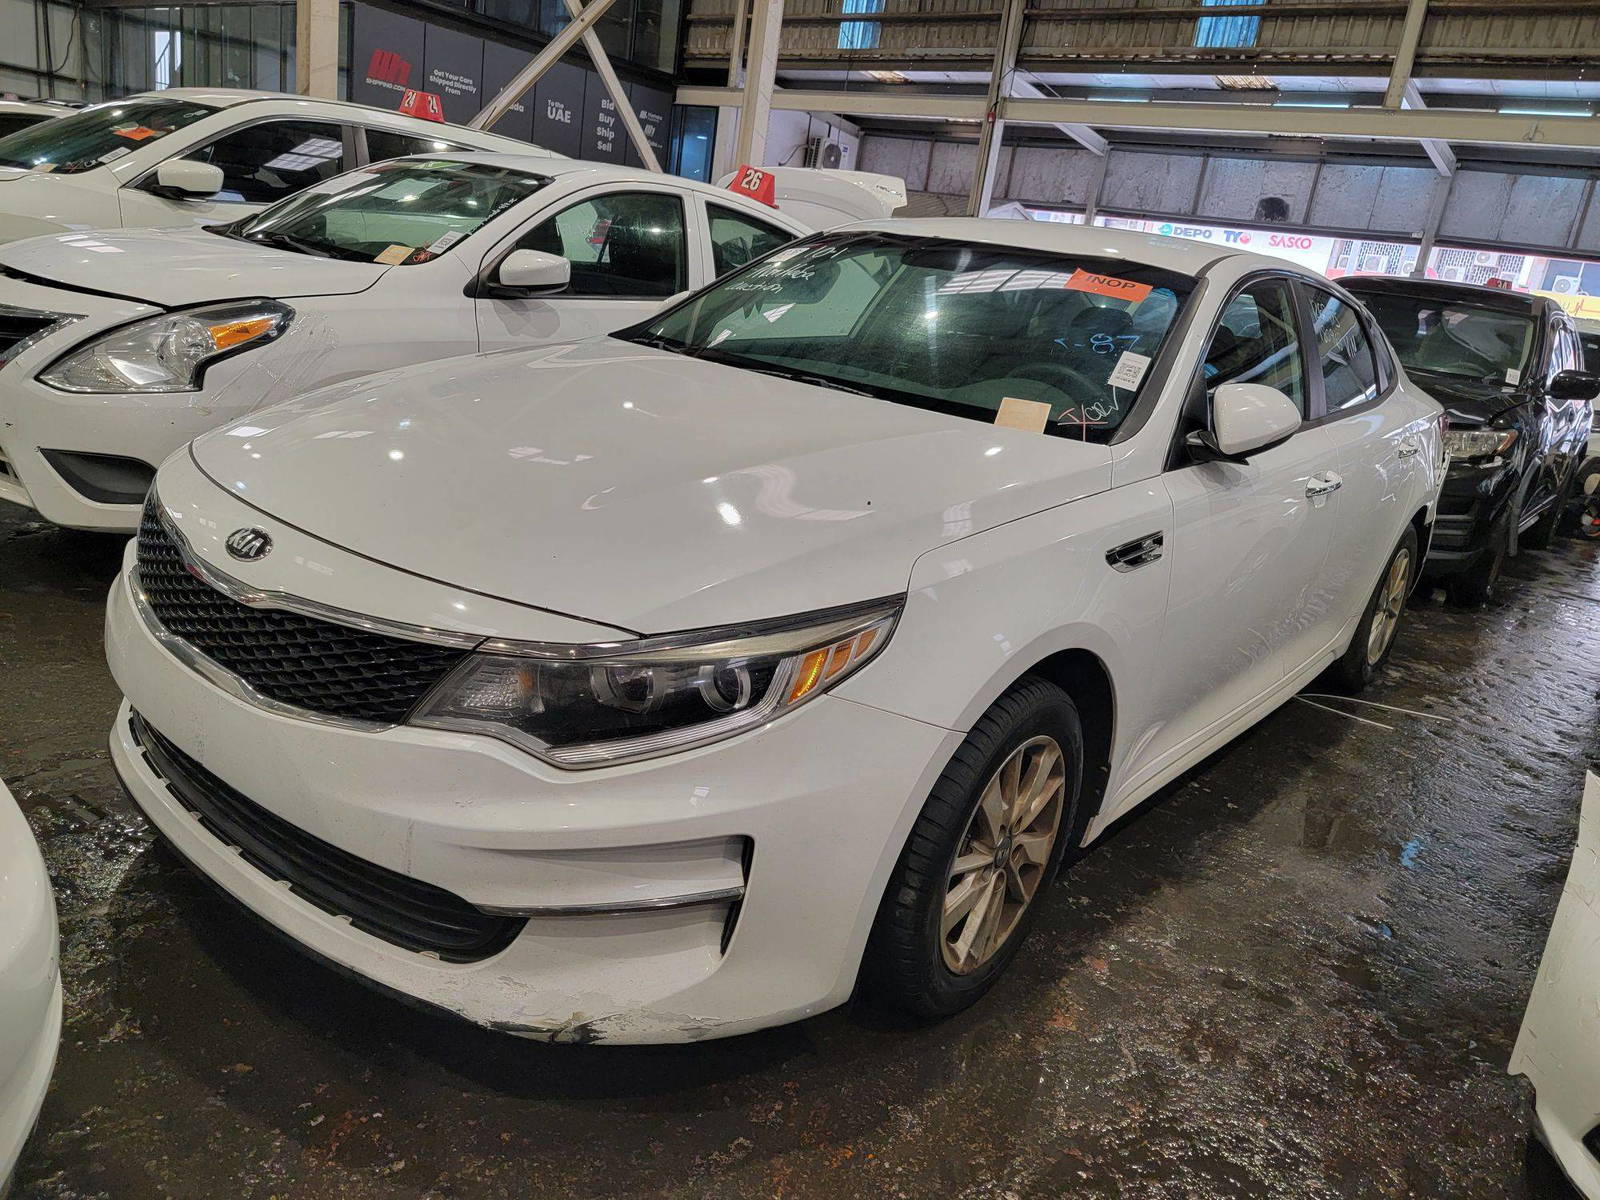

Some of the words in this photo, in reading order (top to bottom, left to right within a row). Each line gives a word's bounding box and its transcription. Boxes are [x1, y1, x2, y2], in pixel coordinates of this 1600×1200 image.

[429, 75, 454, 87] Shipped
[454, 82, 477, 94] Directly
[445, 72, 459, 81] Your
[459, 76, 473, 85] Cars
[445, 87, 461, 96] From
[405, 91, 417, 108] 24
[428, 96, 438, 113] 24
[547, 99, 554, 107] To
[555, 101, 564, 109] the
[601, 99, 615, 111] Bid
[547, 106, 571, 124] UAE
[598, 113, 615, 127] Buy
[596, 126, 615, 141] Ship
[597, 140, 612, 153] Sell
[741, 168, 763, 191] 26
[1173, 226, 1212, 239] DEPO
[1269, 234, 1312, 250] SASCO
[1087, 275, 1136, 289] INOP
